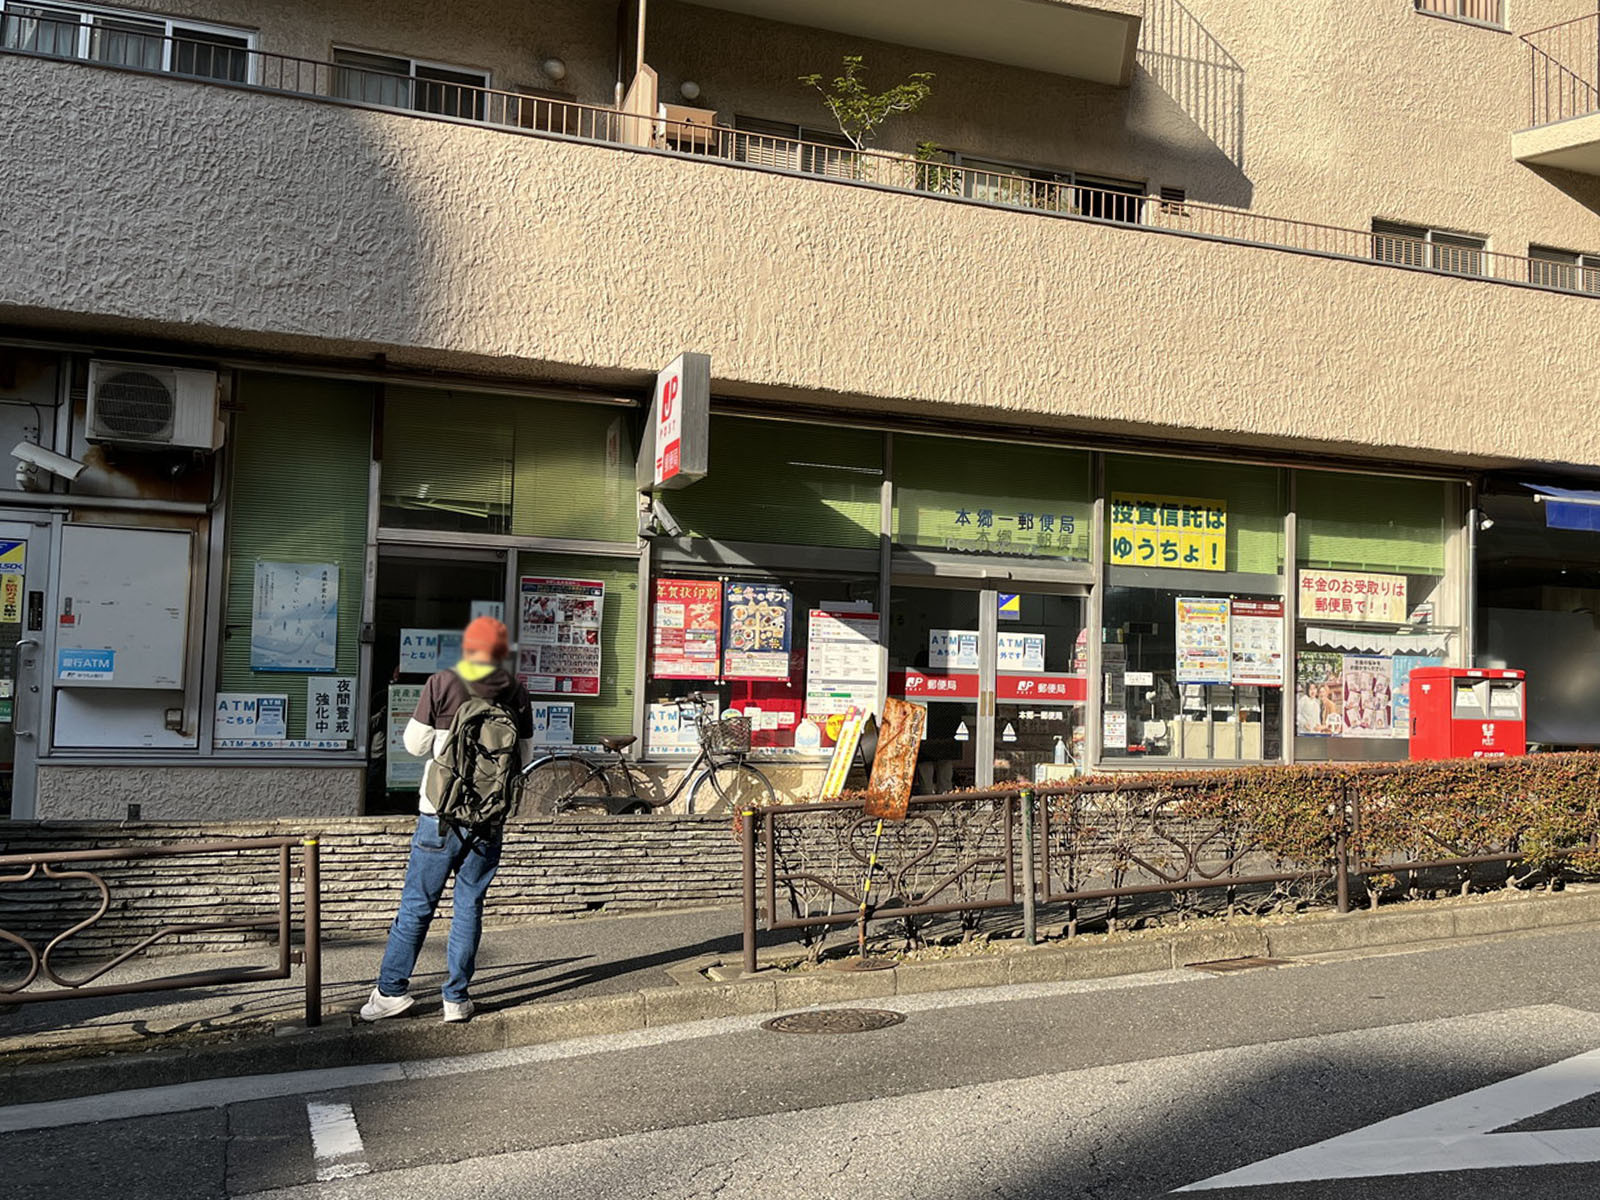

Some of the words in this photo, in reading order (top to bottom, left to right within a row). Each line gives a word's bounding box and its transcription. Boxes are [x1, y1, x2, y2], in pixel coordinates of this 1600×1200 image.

[1112, 498, 1224, 529] 投資信託は
[955, 508, 1075, 534] 本郷一郵便局
[1113, 536, 1218, 565] ゆうちょ！
[1301, 577, 1405, 597] 年金のお受取りは
[402, 635, 437, 646] ATM
[931, 635, 958, 645] ATM
[999, 639, 1023, 648] ATM
[410, 651, 436, 660] となり
[62, 657, 111, 668] 銀行ATM
[927, 679, 957, 691] 郵便局
[1037, 682, 1067, 695] 郵便局
[219, 700, 256, 712] ATM
[335, 679, 352, 734] 夜間警戒
[315, 692, 330, 733] 強化中
[648, 711, 678, 721] ATM
[226, 716, 254, 725] こちら
